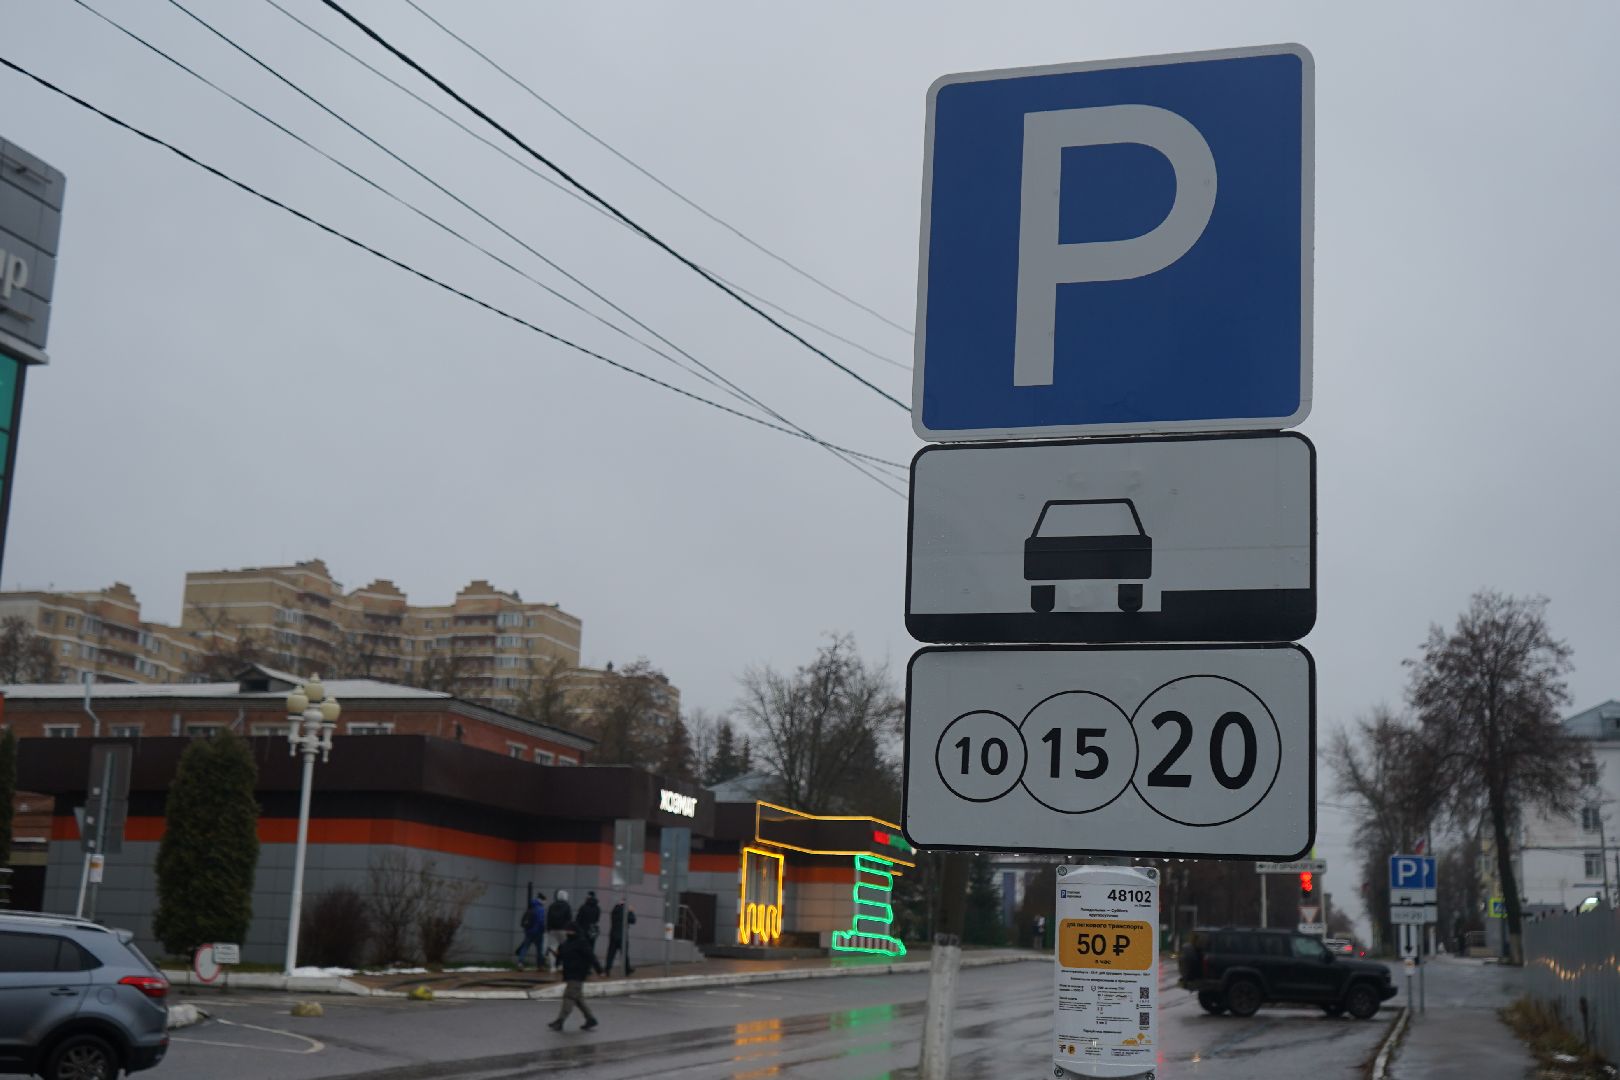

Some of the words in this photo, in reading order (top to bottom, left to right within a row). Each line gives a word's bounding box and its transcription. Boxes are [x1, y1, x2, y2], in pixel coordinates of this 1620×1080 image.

[1013, 104, 1218, 386] P
[954, 736, 1009, 776] 10
[1041, 727, 1110, 780] 15
[1147, 710, 1258, 790] 20
[1107, 889, 1152, 903] 48102
[1108, 923, 1144, 931] транспорта
[1077, 933, 1107, 955] 50
